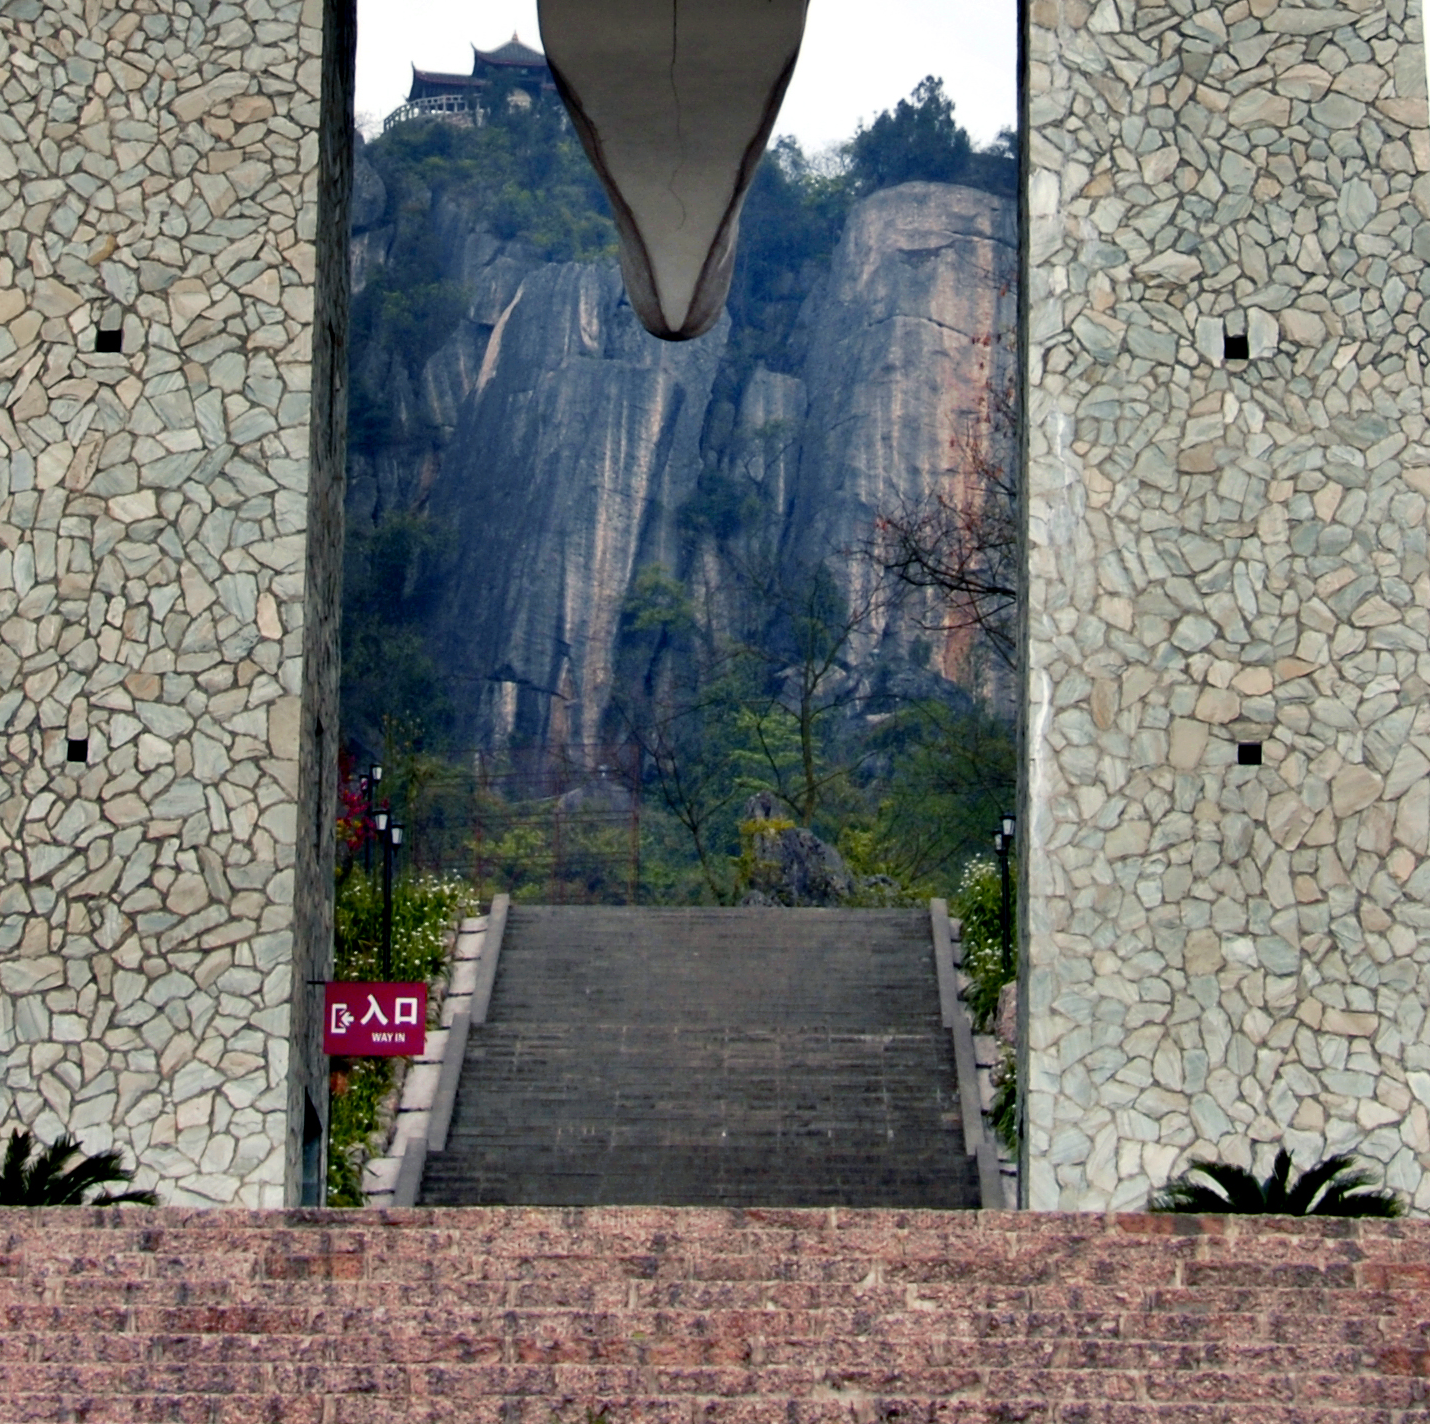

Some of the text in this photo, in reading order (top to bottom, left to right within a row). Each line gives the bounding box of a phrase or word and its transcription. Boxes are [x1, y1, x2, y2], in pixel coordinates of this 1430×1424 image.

[360, 993, 418, 1026] 入口
[371, 1031, 406, 1043] WAY IN
